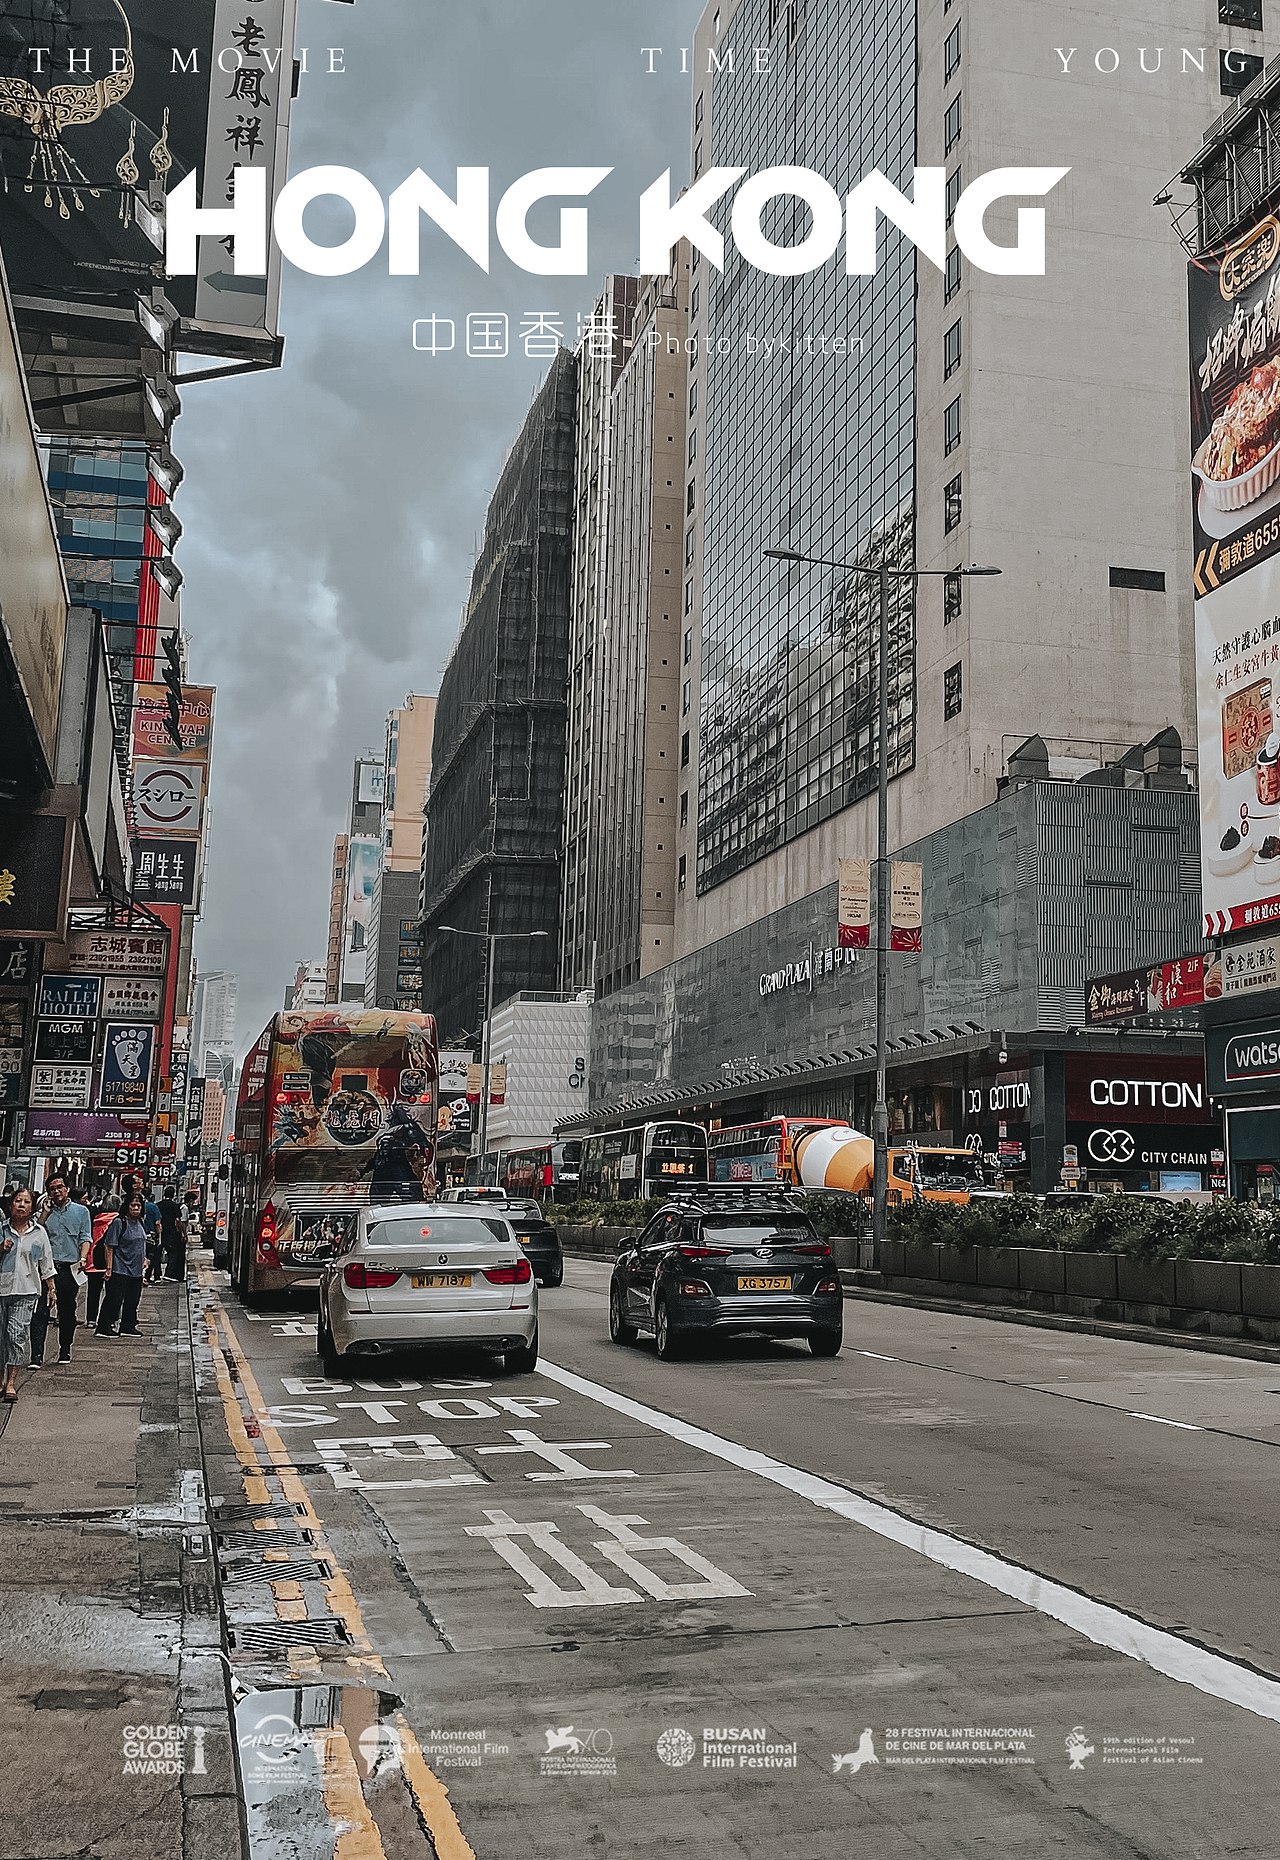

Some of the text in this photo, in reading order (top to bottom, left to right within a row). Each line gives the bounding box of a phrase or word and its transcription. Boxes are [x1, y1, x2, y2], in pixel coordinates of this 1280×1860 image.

[218, 15, 271, 259] 老鳳祥
[1219, 514, 1280, 574] 彌敦道655
[141, 721, 169, 732] KIN
[149, 734, 195, 746] CENRE
[133, 788, 198, 803] スシロー
[141, 851, 184, 880] 周生生
[90, 936, 163, 954] 志城賓館
[1, 942, 28, 979] 店
[43, 1002, 95, 1016] HOTEL
[48, 1023, 83, 1034] MGM
[121, 1041, 139, 1077] 滿天星
[1090, 1079, 1202, 1108] COTTON
[116, 1148, 148, 1164] S15
[1141, 1151, 1207, 1165] CITY CHAIN
[149, 1166, 170, 1177] S16
[688, 1163, 694, 1174] 1
[439, 1275, 466, 1286] 7187
[742, 1278, 788, 1289] XG 3757
[280, 1377, 492, 1395] BUS
[258, 1396, 561, 1427] STOP
[312, 1429, 640, 1490] 巴士
[463, 1504, 756, 1608] 站
